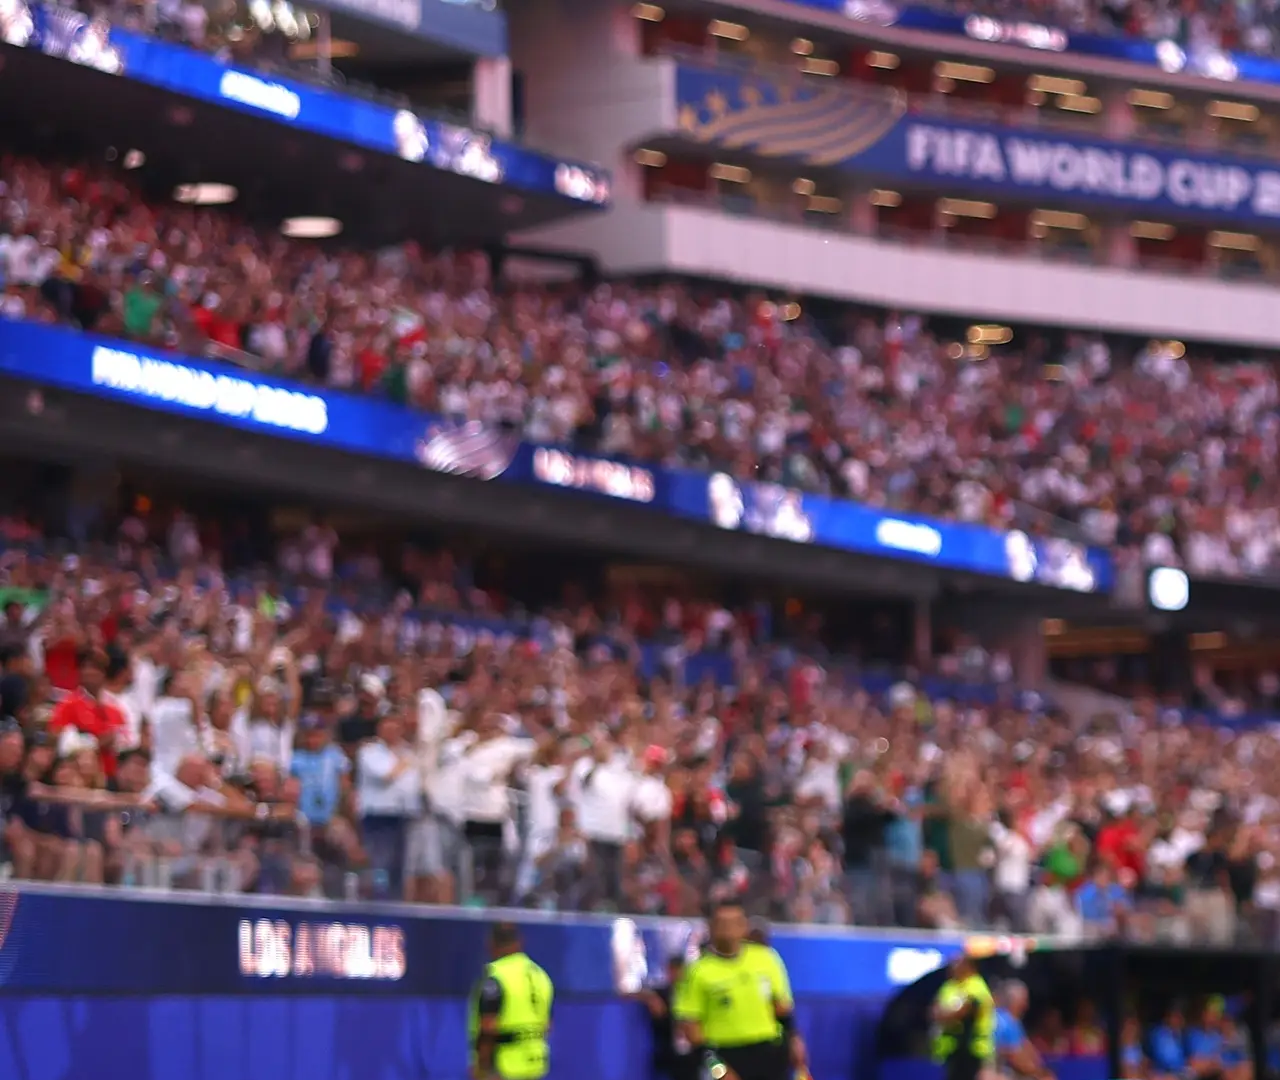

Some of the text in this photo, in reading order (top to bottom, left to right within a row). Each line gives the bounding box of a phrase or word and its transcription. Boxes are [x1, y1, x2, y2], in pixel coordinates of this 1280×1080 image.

[905, 124, 1006, 182] FIFA
[1007, 137, 1163, 201] WORLD
[1167, 159, 1252, 210] CUP
